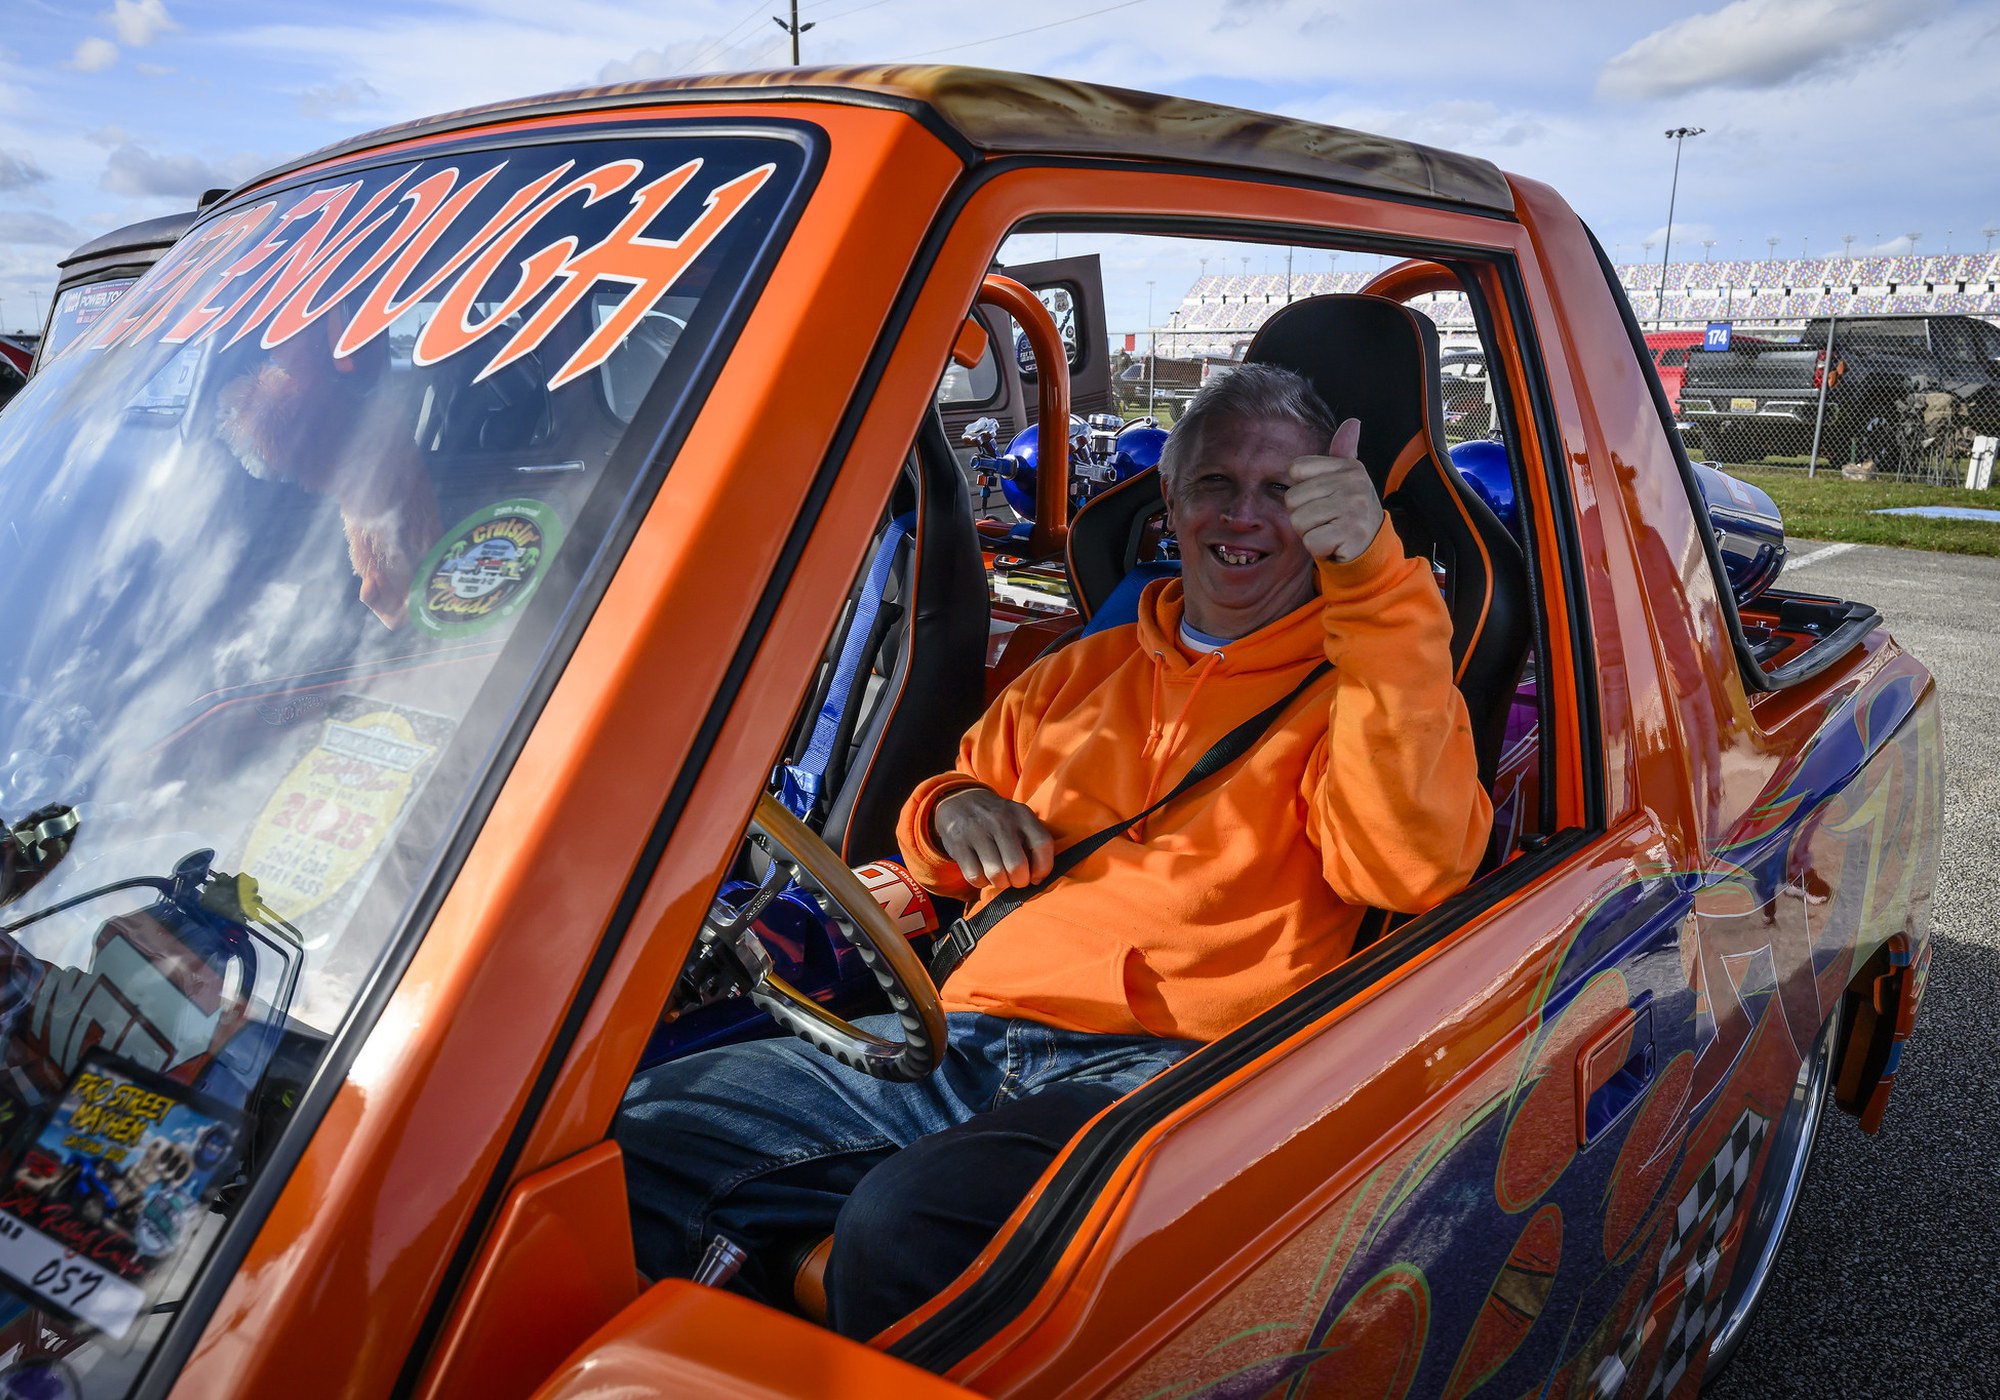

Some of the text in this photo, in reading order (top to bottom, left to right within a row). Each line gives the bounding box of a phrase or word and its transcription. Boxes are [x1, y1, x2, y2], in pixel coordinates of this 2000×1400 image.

[159, 158, 777, 392] ENOUGH
[80, 292, 107, 307] POWER
[1708, 329, 1728, 345] 174
[428, 590, 503, 615] Coast
[271, 792, 377, 850] 2025
[302, 852, 329, 876] CAR
[290, 873, 325, 897] PASS
[898, 871, 926, 903] Nitrous
[70, 1072, 176, 1126] PRO STREET
[69, 1103, 149, 1148] MAYHEM
